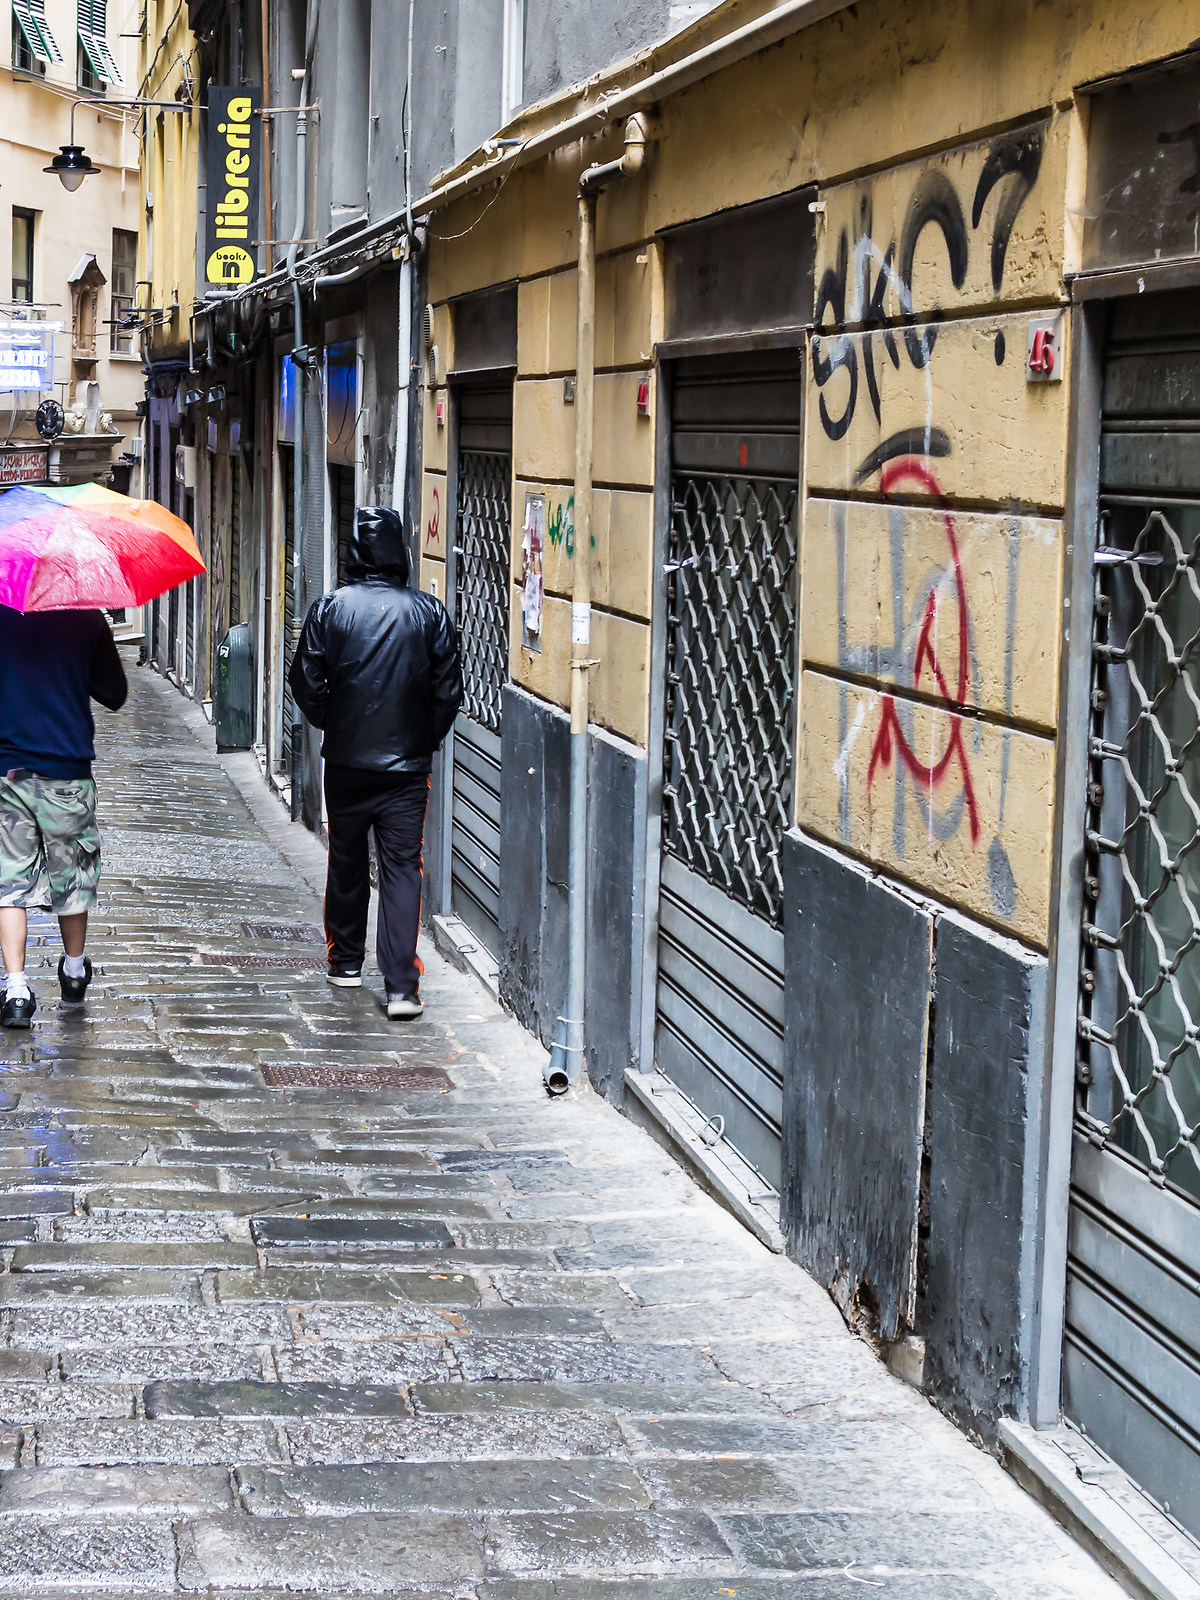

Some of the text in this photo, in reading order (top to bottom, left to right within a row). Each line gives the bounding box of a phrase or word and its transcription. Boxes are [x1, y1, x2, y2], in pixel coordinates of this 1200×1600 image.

[214, 97, 252, 239] libreria
[216, 252, 247, 261] books
[1028, 327, 1055, 374] 46
